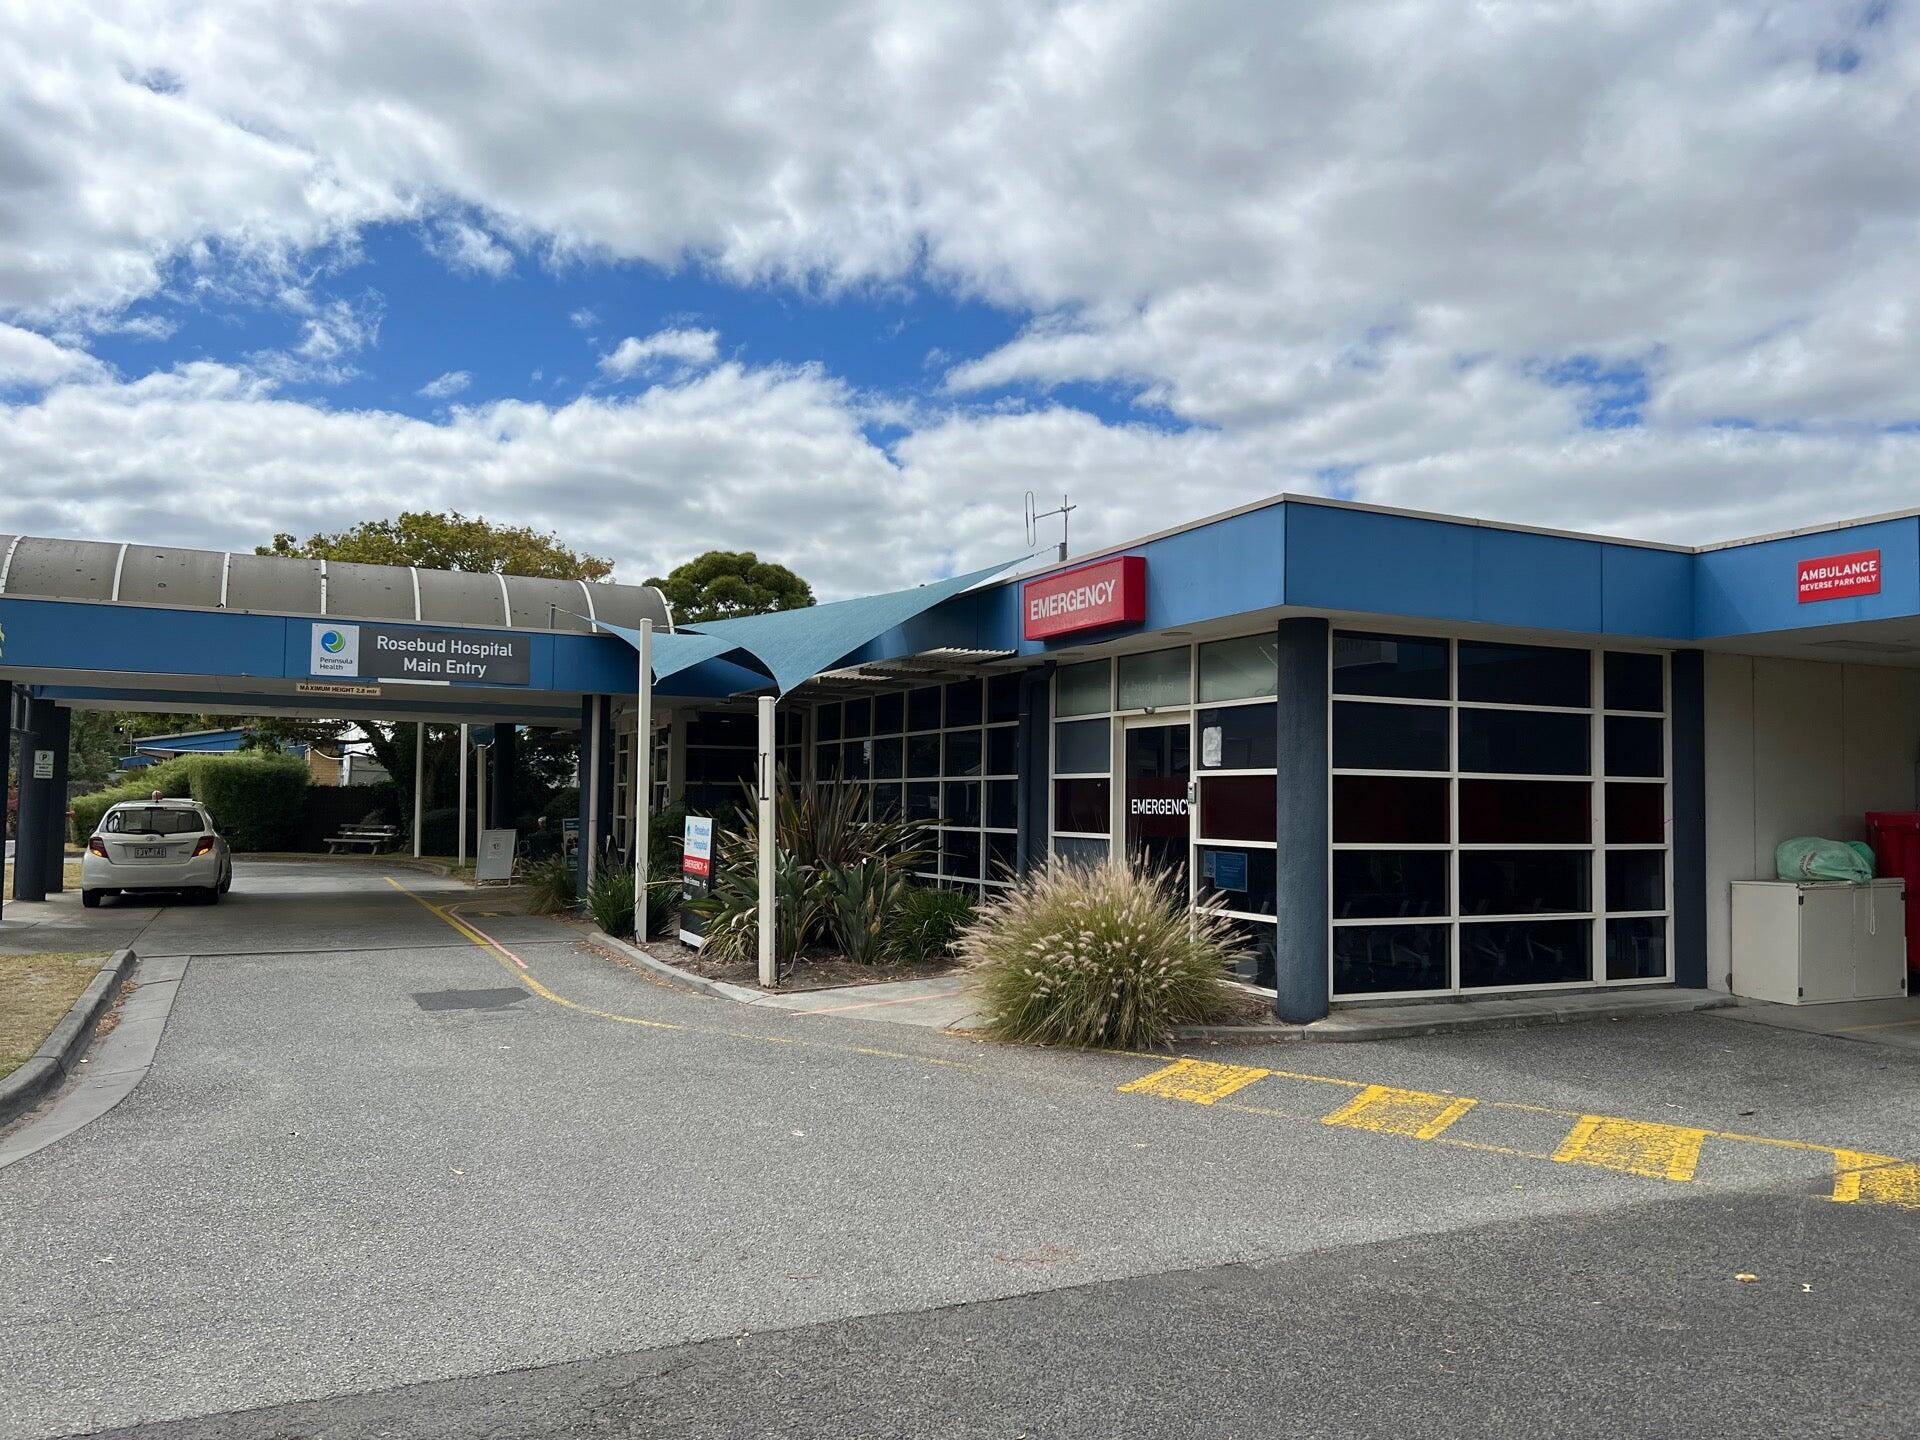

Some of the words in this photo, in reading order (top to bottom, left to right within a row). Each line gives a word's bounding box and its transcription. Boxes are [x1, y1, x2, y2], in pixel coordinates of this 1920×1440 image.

[1800, 560, 1877, 581] AMBULANCE
[1800, 580, 1833, 591] REVERSE
[1834, 576, 1855, 587] PARK
[1856, 574, 1877, 584] ONLY
[1030, 579, 1116, 621] EMERGENCY
[377, 635, 446, 653] Rosebud
[450, 639, 513, 659] Hospital
[319, 656, 353, 664] Peninsula
[403, 657, 441, 673] Main
[446, 659, 487, 678] Entry
